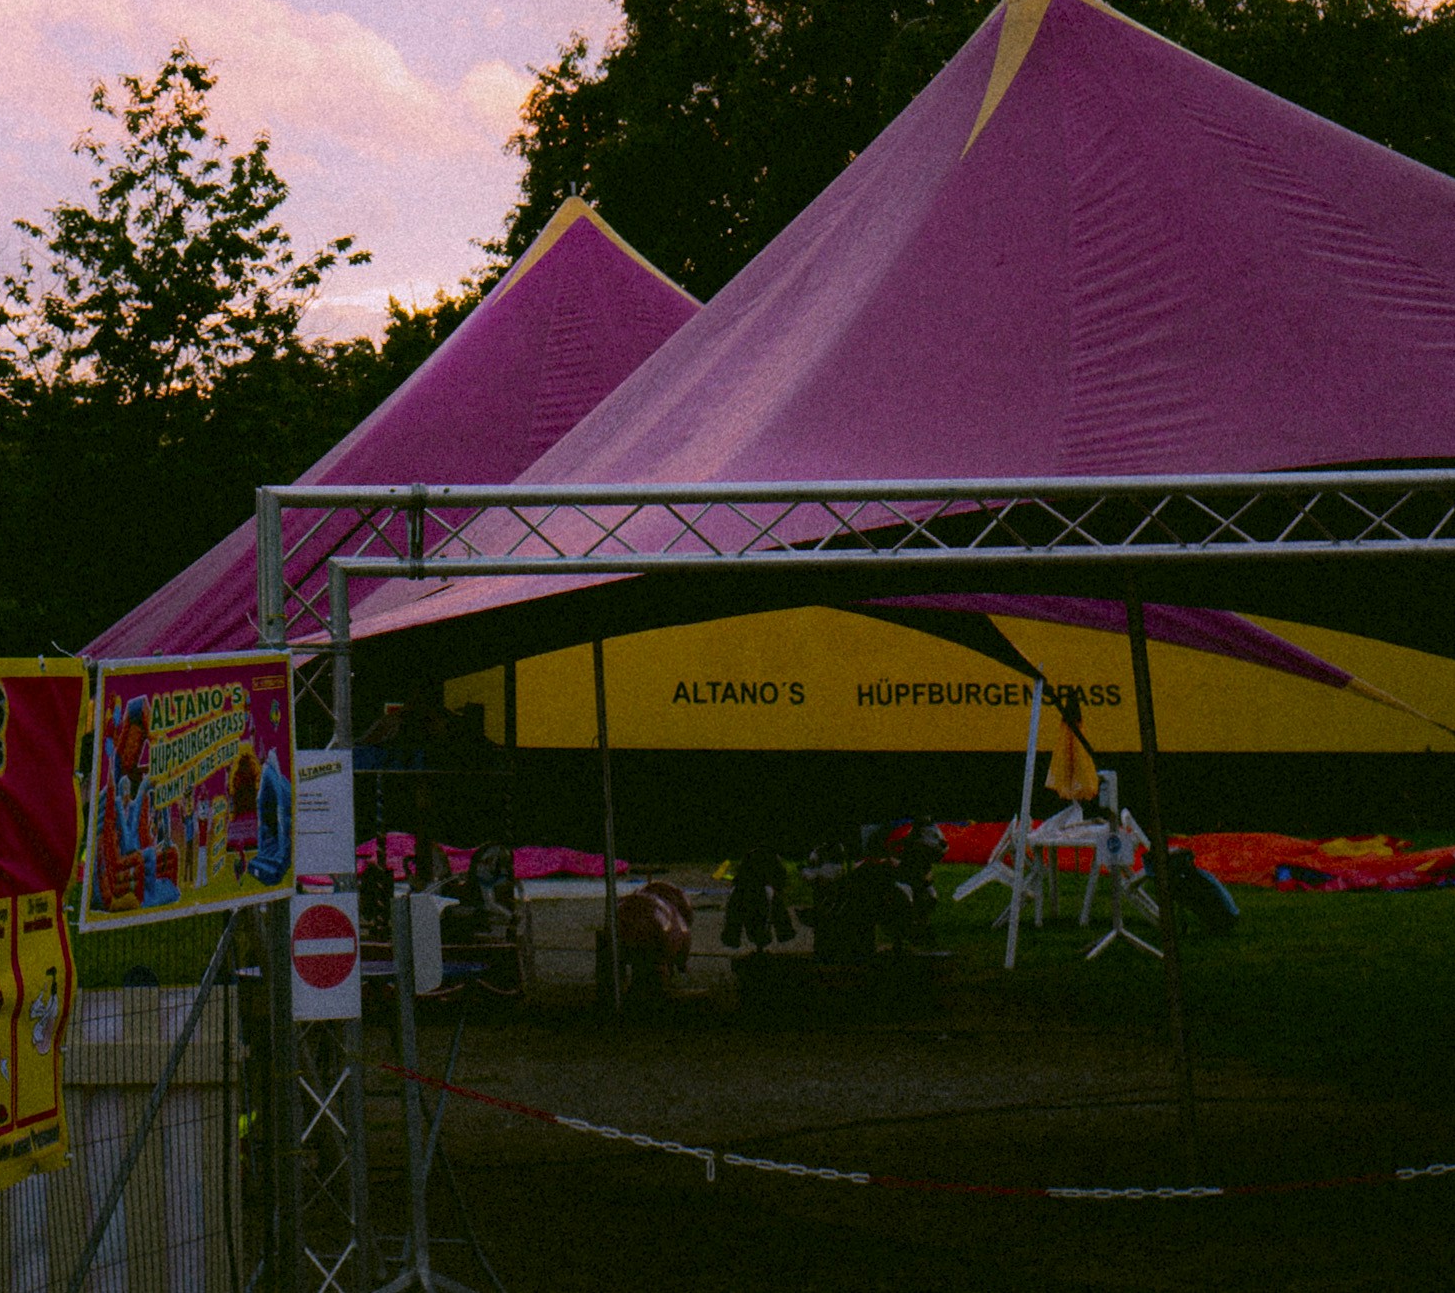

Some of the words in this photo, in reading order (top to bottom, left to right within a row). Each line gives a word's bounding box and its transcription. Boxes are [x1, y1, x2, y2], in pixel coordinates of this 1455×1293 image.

[150, 711, 244, 777] HÜPFBURGENSPASS
[156, 776, 184, 806] KOMMT
[186, 770, 196, 787] IN
[197, 757, 215, 781] IHRE
[217, 741, 239, 765] STADT
